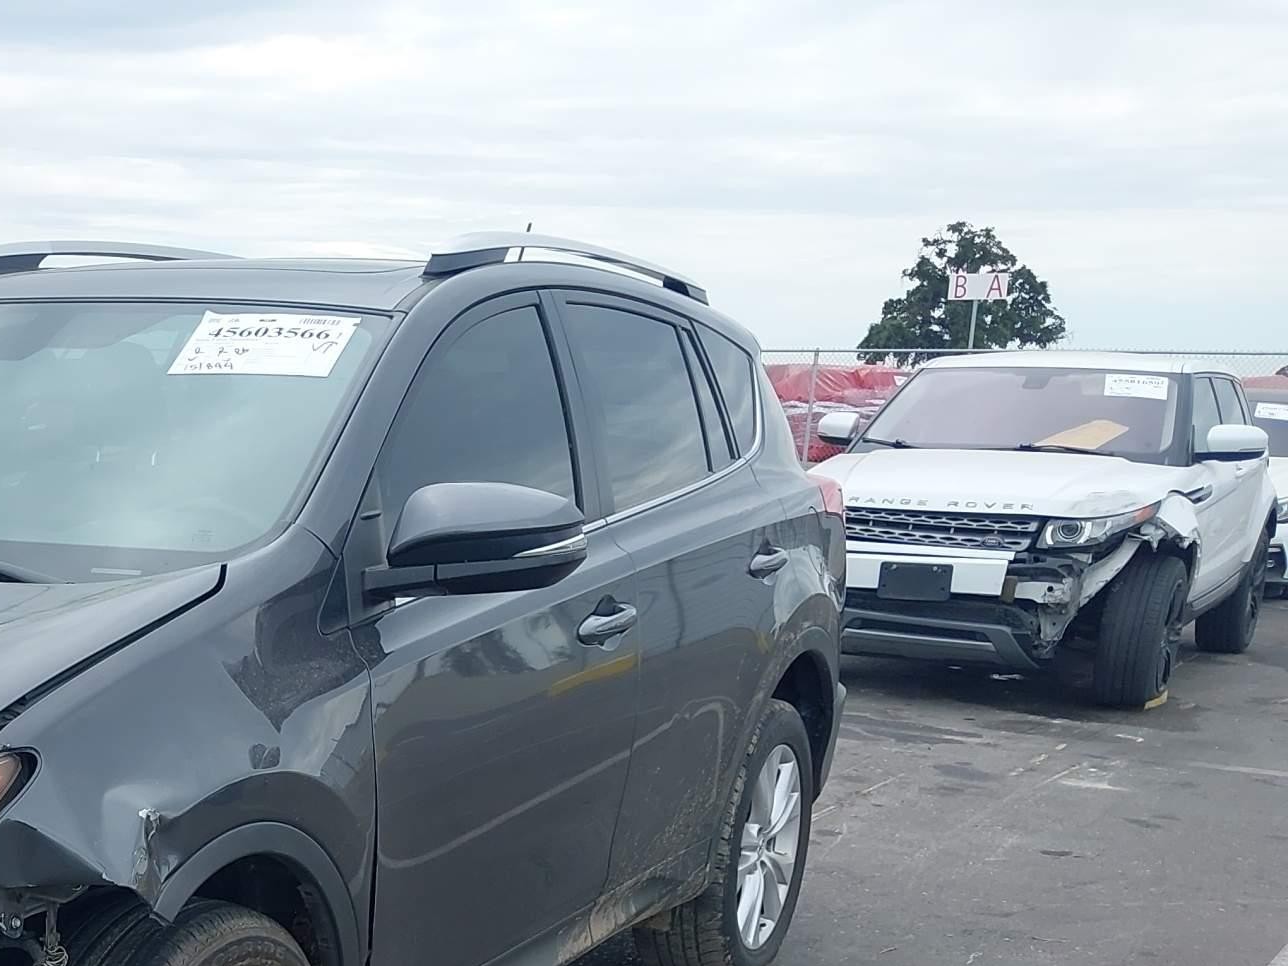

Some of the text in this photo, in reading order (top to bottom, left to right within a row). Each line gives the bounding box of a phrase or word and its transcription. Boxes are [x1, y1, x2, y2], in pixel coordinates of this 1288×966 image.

[954, 274, 1003, 299] B A
[208, 326, 331, 340] 45603566
[848, 496, 1034, 511] RANGE ROVER
